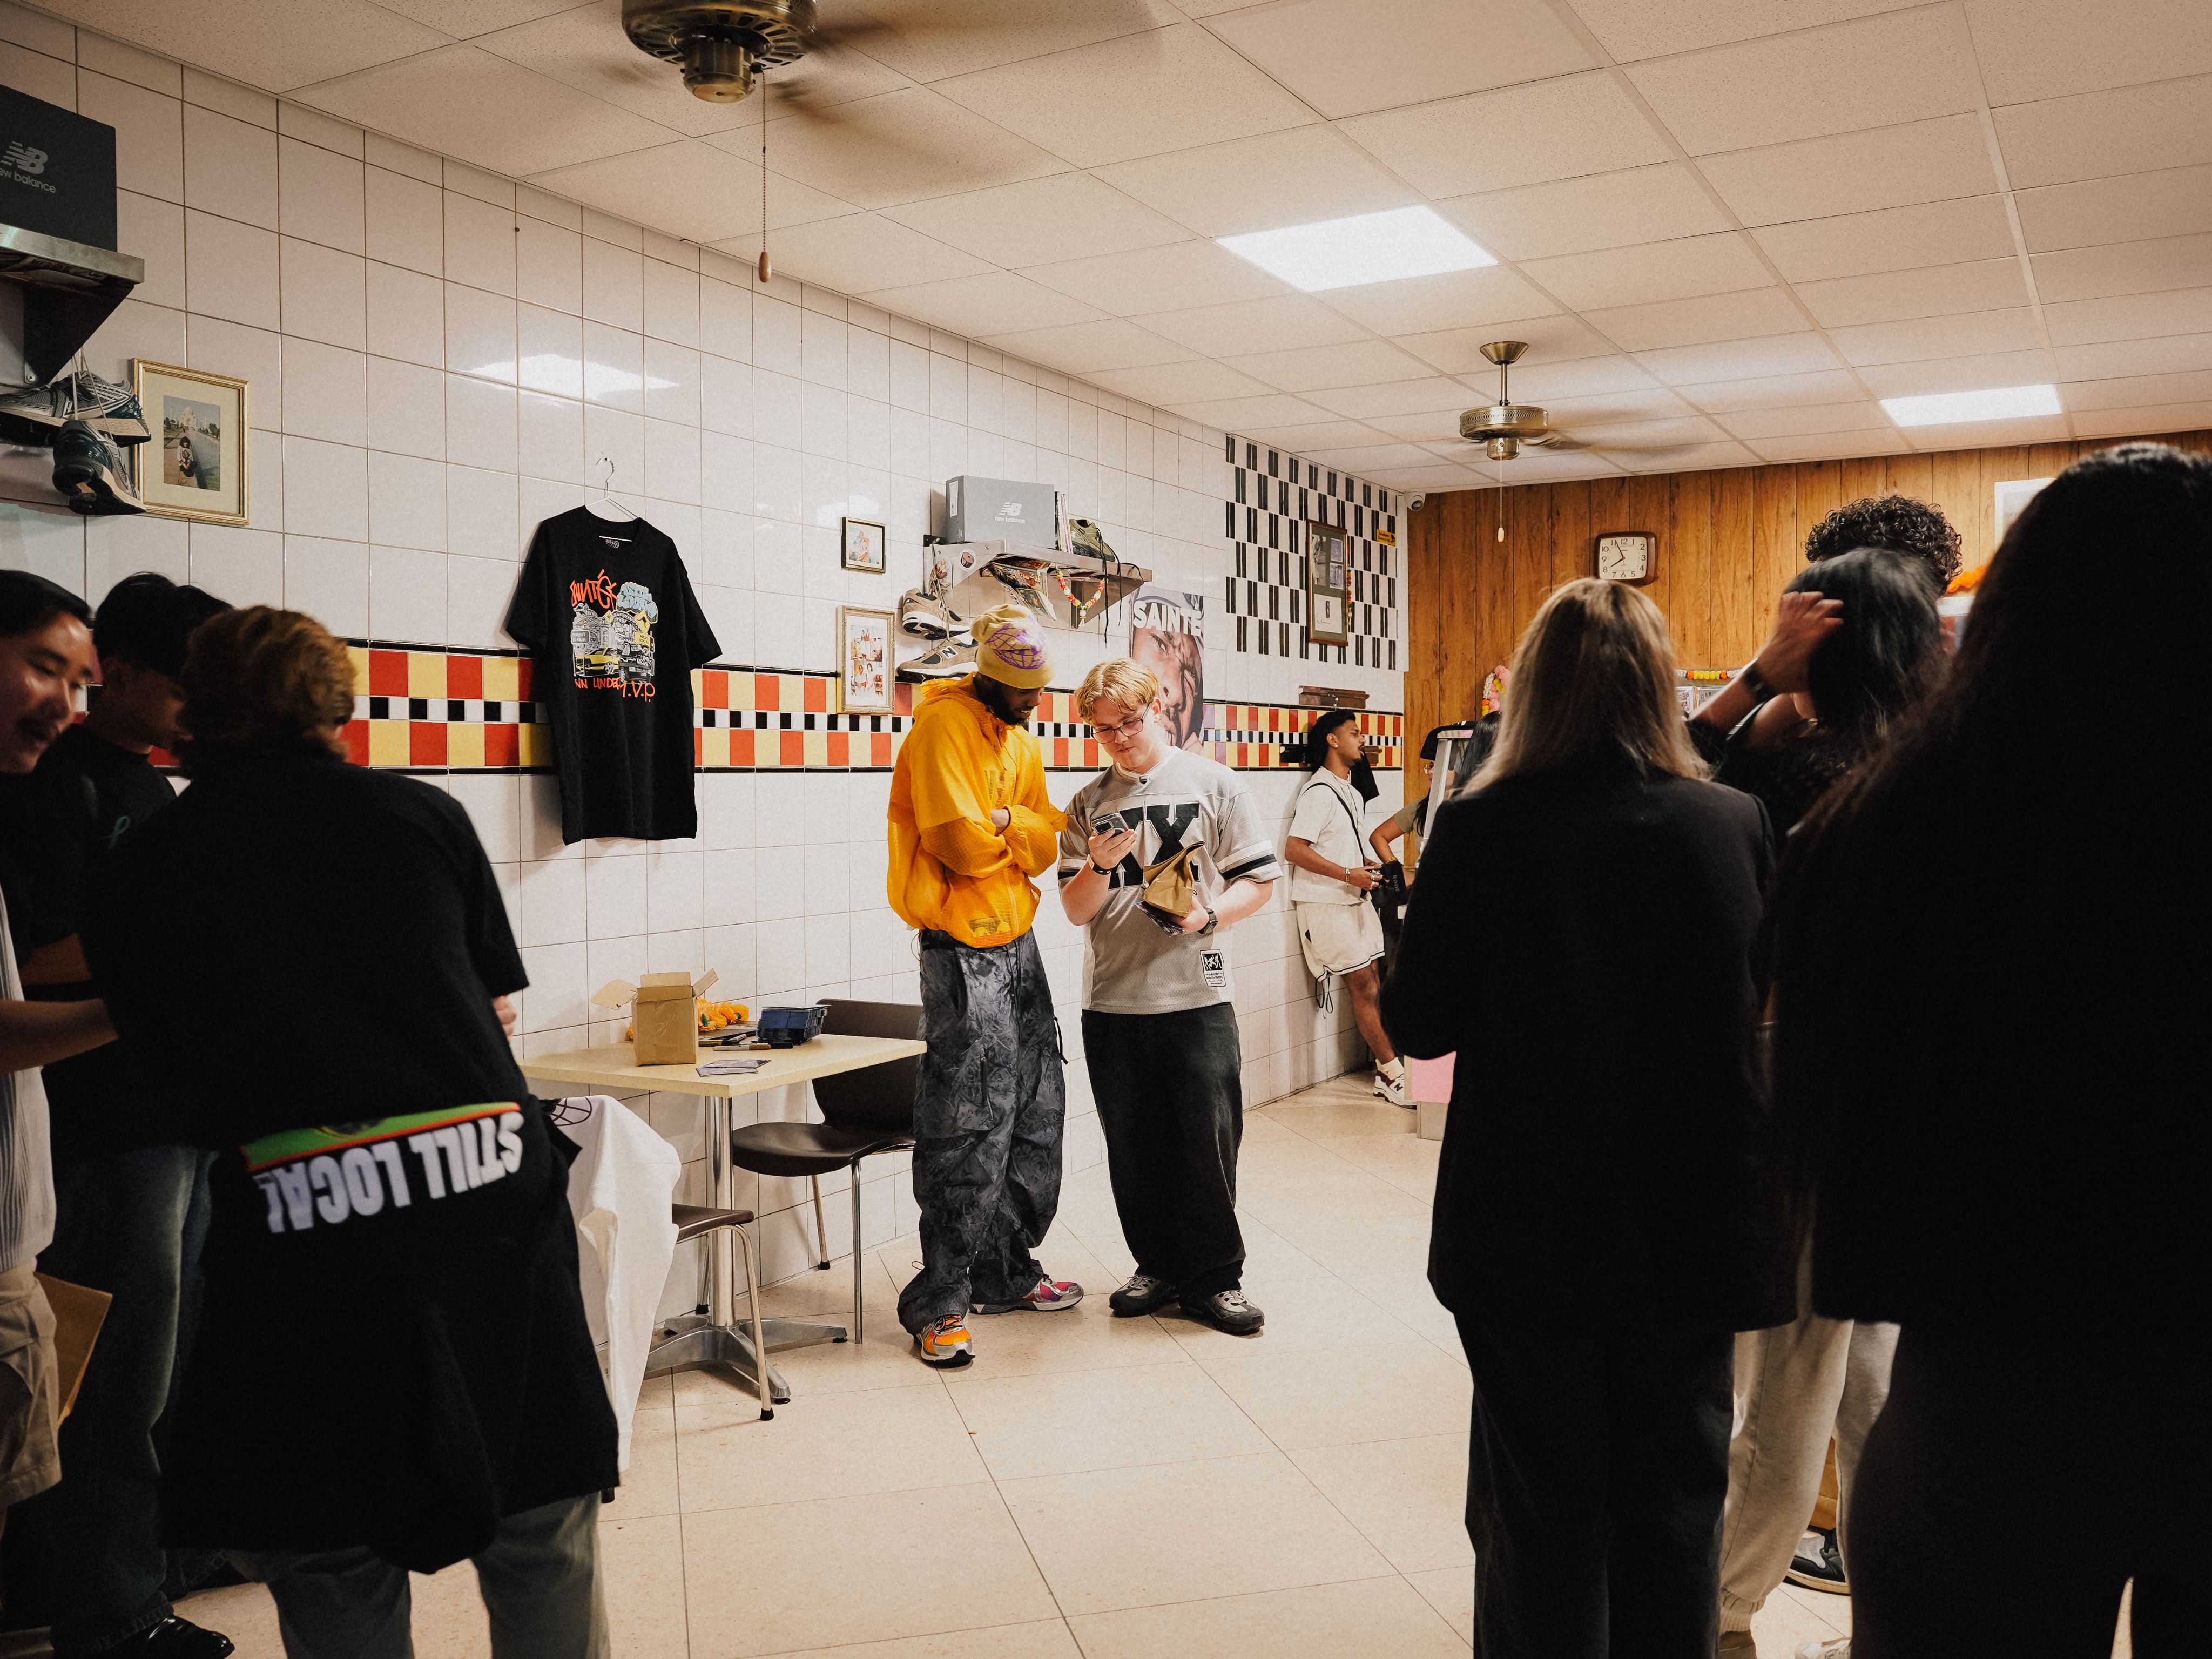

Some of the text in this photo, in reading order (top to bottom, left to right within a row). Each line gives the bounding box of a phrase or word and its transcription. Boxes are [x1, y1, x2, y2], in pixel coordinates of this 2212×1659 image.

[0, 168, 56, 193] ew balance
[941, 646, 956, 658] N
[252, 1111, 524, 1233] STILL LOCAL
